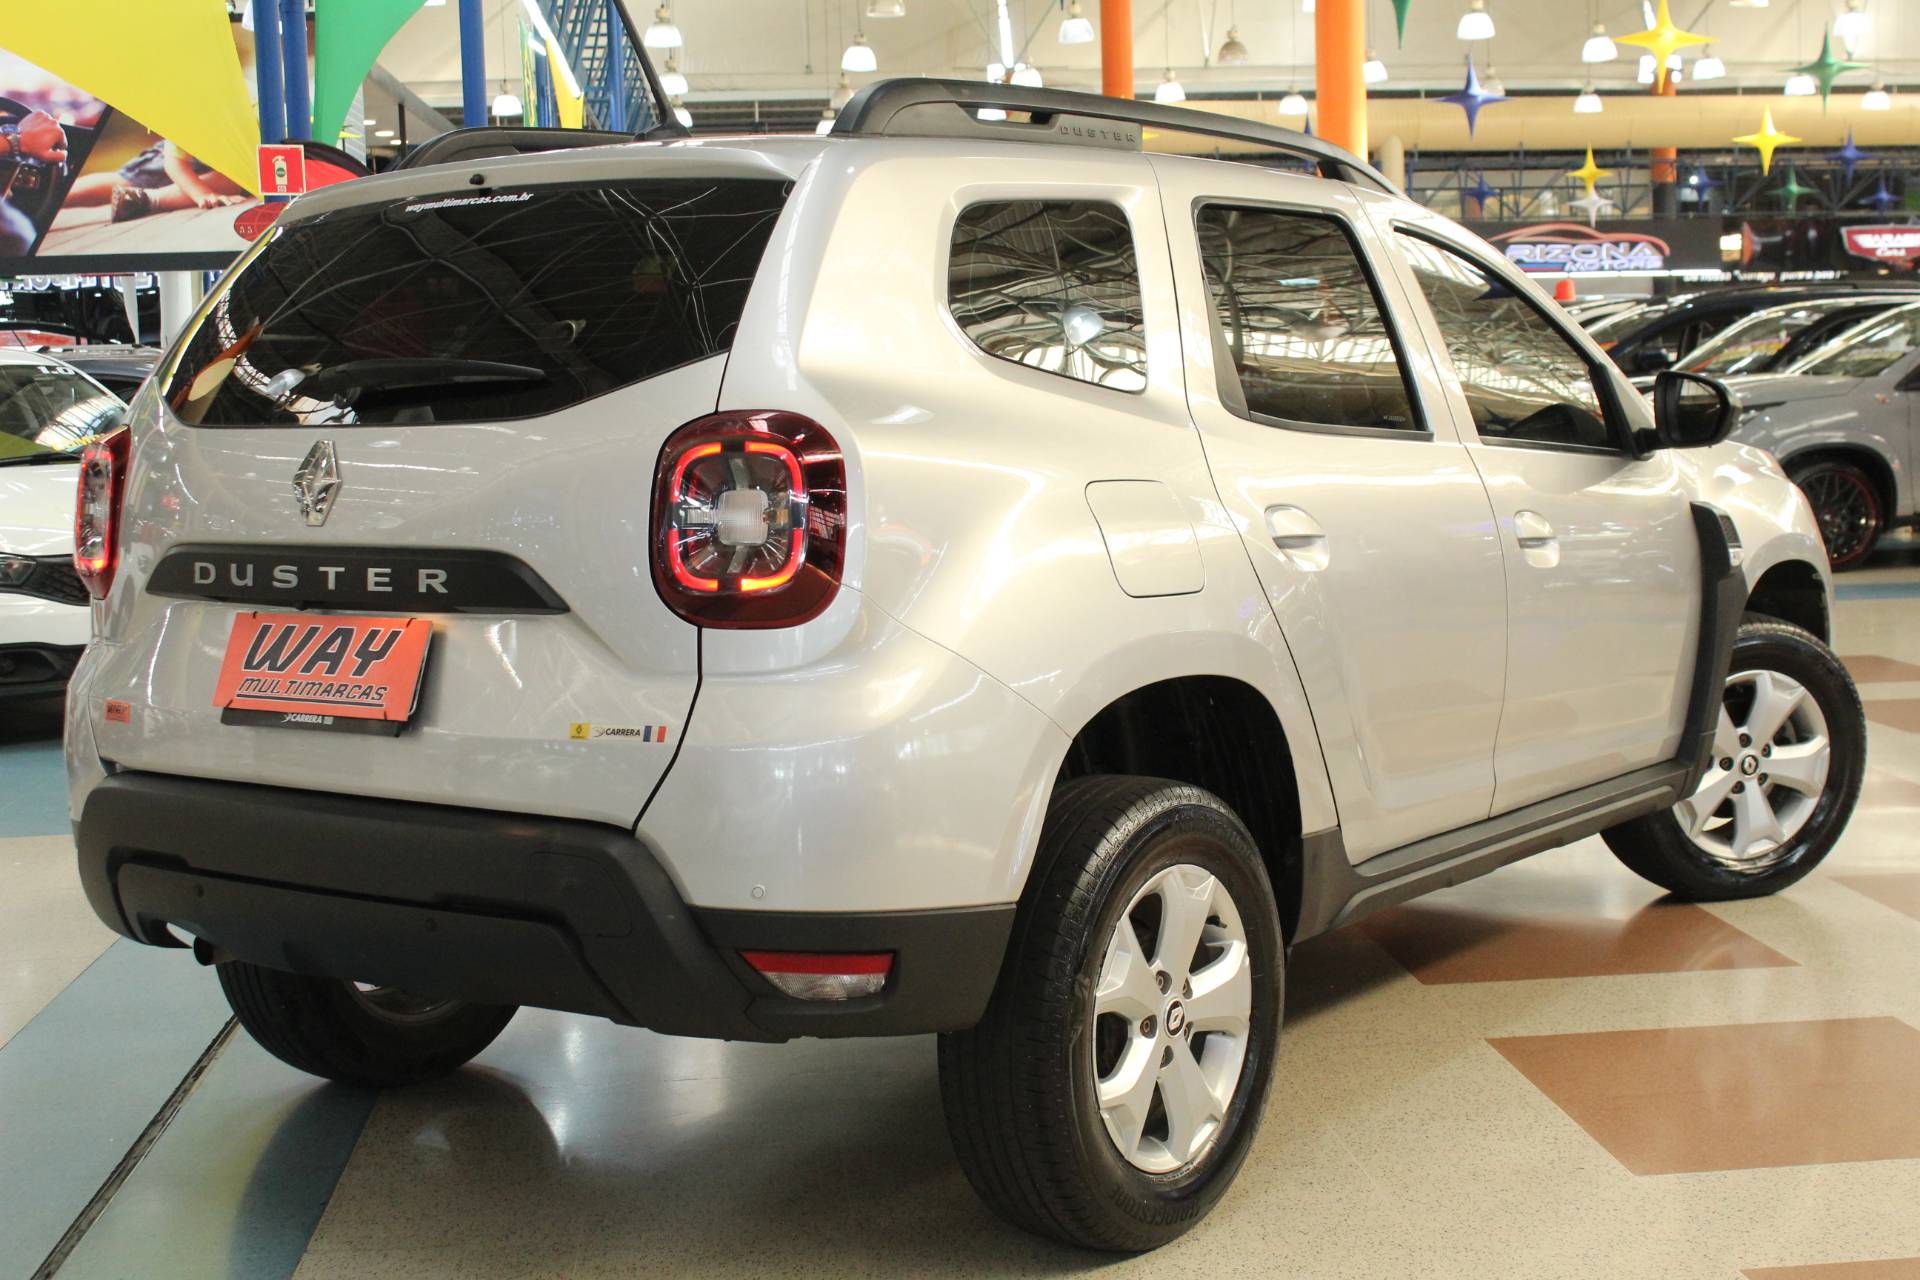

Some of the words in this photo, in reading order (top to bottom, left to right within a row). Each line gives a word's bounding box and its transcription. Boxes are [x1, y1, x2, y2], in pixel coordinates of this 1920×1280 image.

[1060, 126, 1136, 143] DUSTER
[405, 192, 534, 212] waymultimarcas.com.br
[37, 366, 75, 375] 1.0
[193, 561, 449, 594] DUSTER
[241, 622, 405, 679] WAY
[238, 677, 388, 701] MULTIMARCAS
[605, 727, 641, 737] CARRERA
